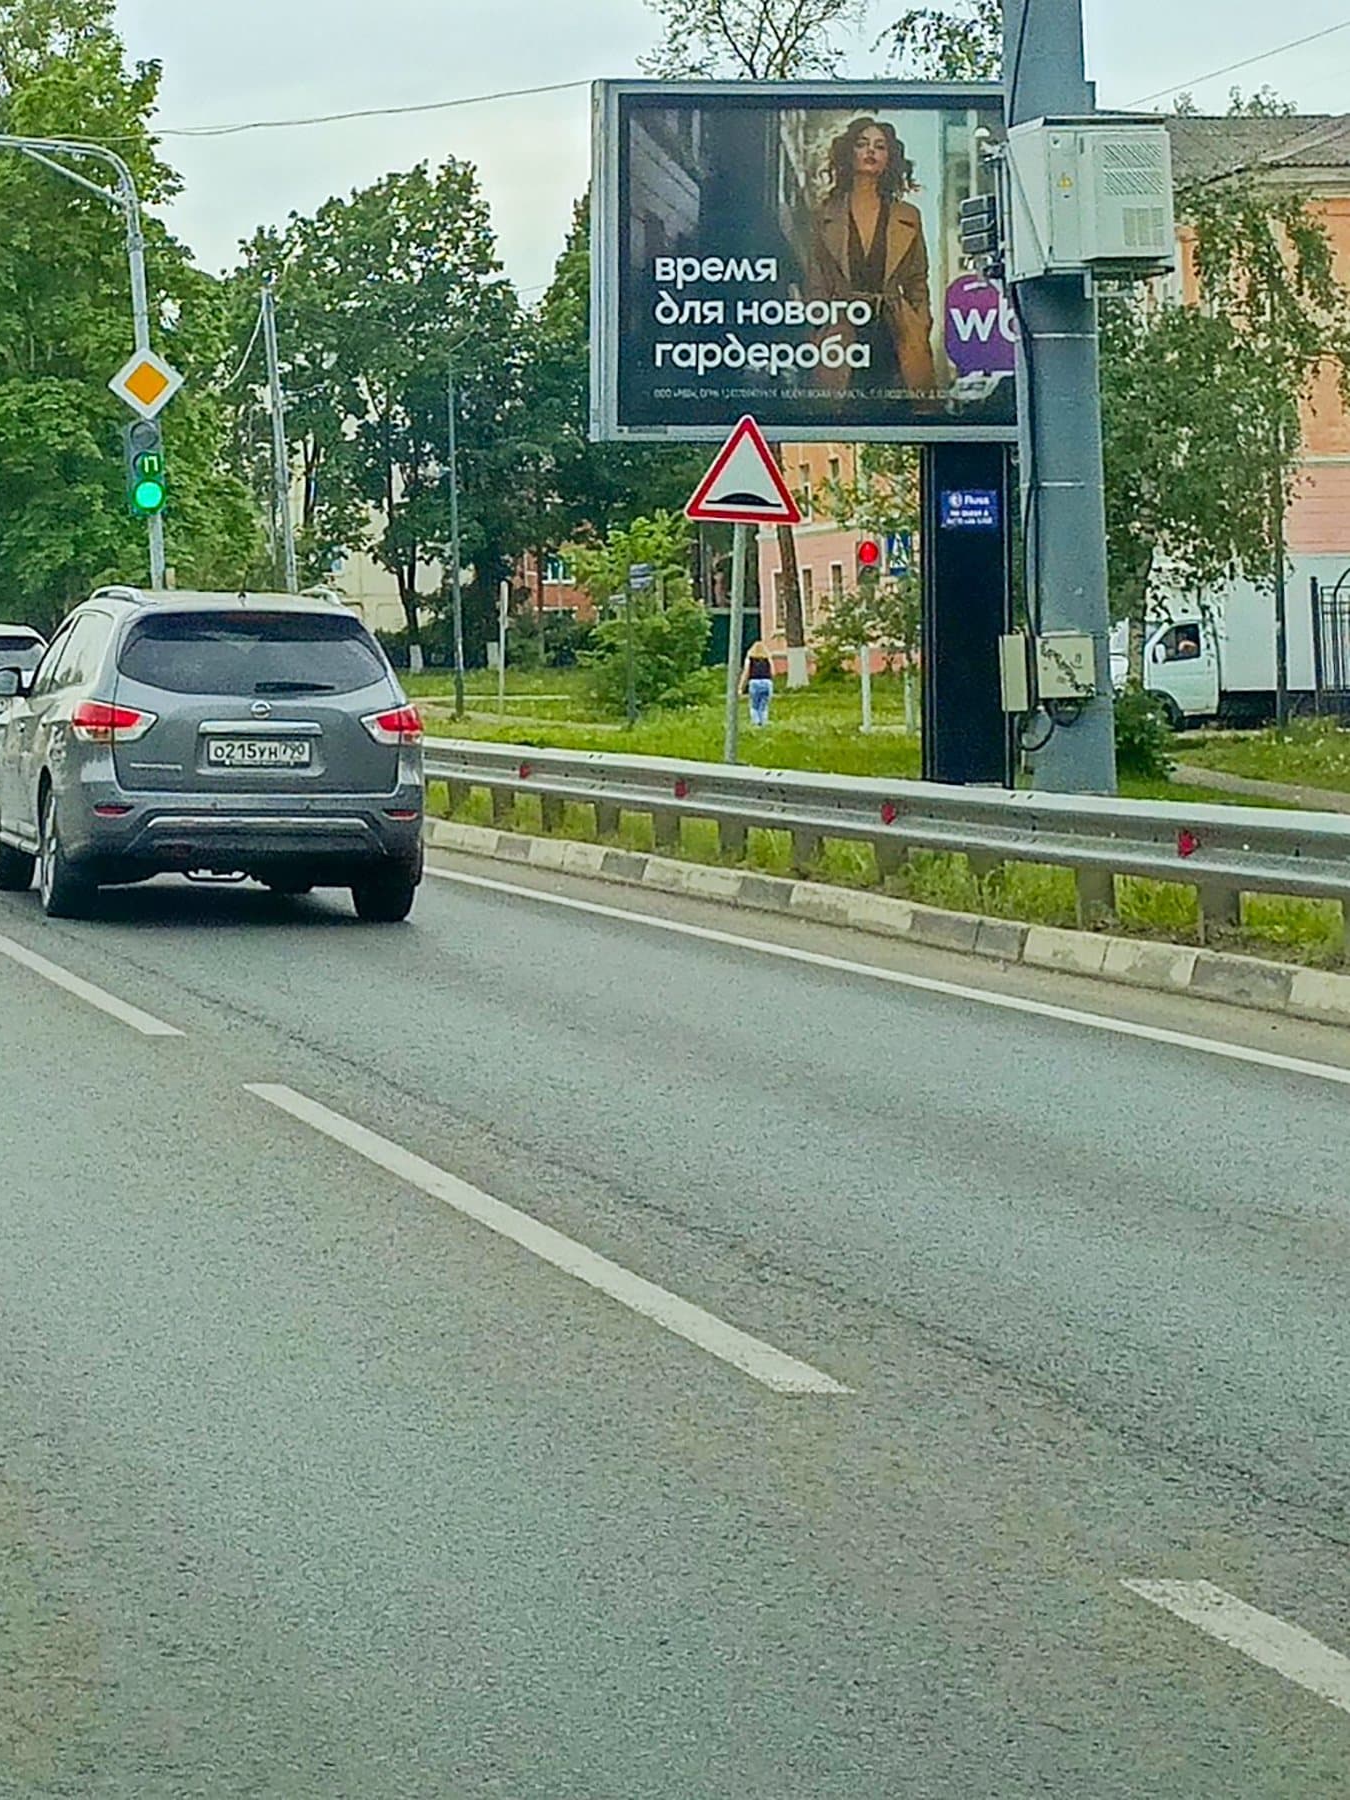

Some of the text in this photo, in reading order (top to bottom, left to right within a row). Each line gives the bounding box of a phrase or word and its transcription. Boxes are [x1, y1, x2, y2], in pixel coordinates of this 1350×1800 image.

[654, 256, 778, 290] время
[654, 290, 873, 325] для нового
[654, 333, 871, 376] гардероба
